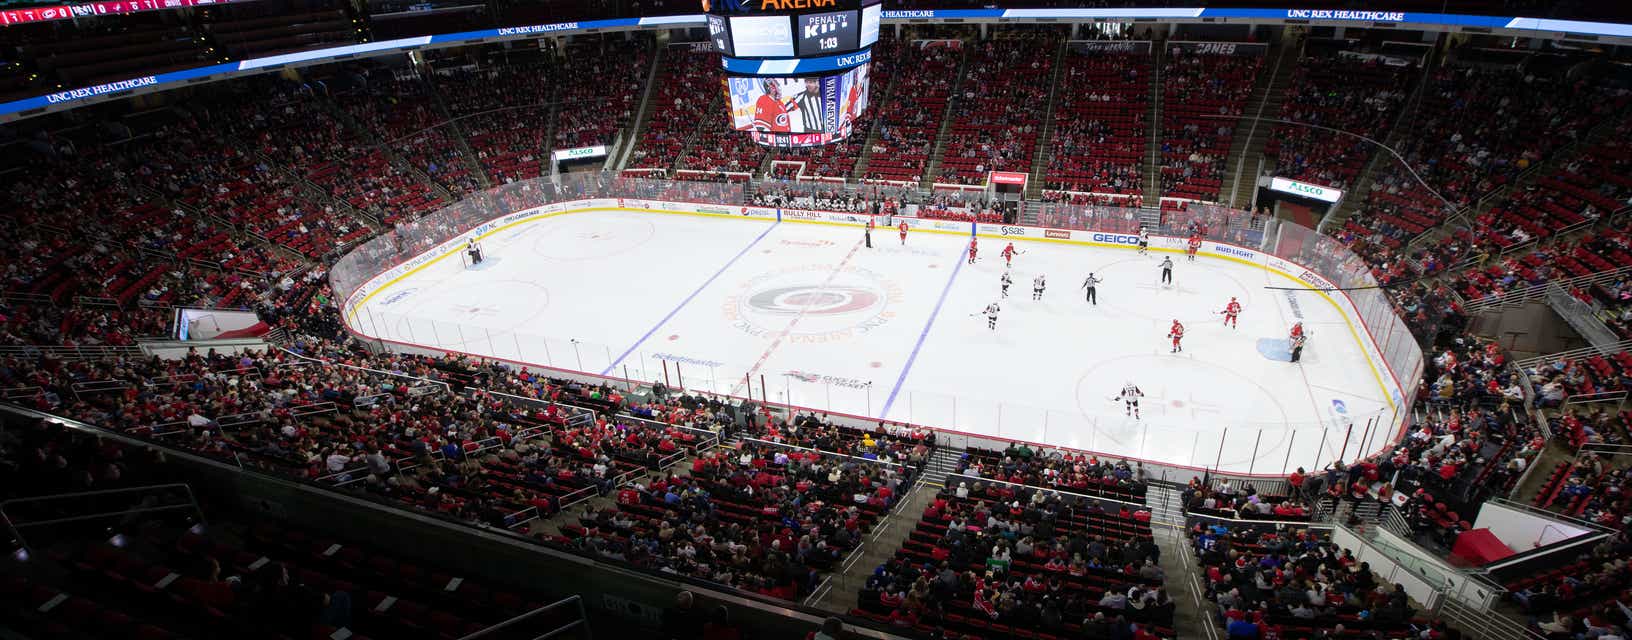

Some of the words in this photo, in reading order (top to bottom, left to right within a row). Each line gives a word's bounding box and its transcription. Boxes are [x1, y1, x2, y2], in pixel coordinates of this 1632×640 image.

[809, 14, 847, 25] PENALTY
[1287, 10, 1310, 18] UNC
[1311, 10, 1332, 18] REX
[1334, 11, 1405, 21] HEALTHCARE
[531, 22, 578, 33] HEALTHCARE
[819, 37, 838, 49] 1:03
[1197, 44, 1236, 54] CANES
[837, 55, 855, 66] UNC
[46, 92, 71, 103] UNC
[70, 88, 93, 99] REX
[93, 76, 157, 94] HEALTHCARE
[827, 103, 836, 131] NEWS
[1289, 181, 1322, 195] ALSCO
[1009, 227, 1024, 235] sas
[1093, 234, 1140, 245] GEICO
[1233, 248, 1254, 258] LIGHT
